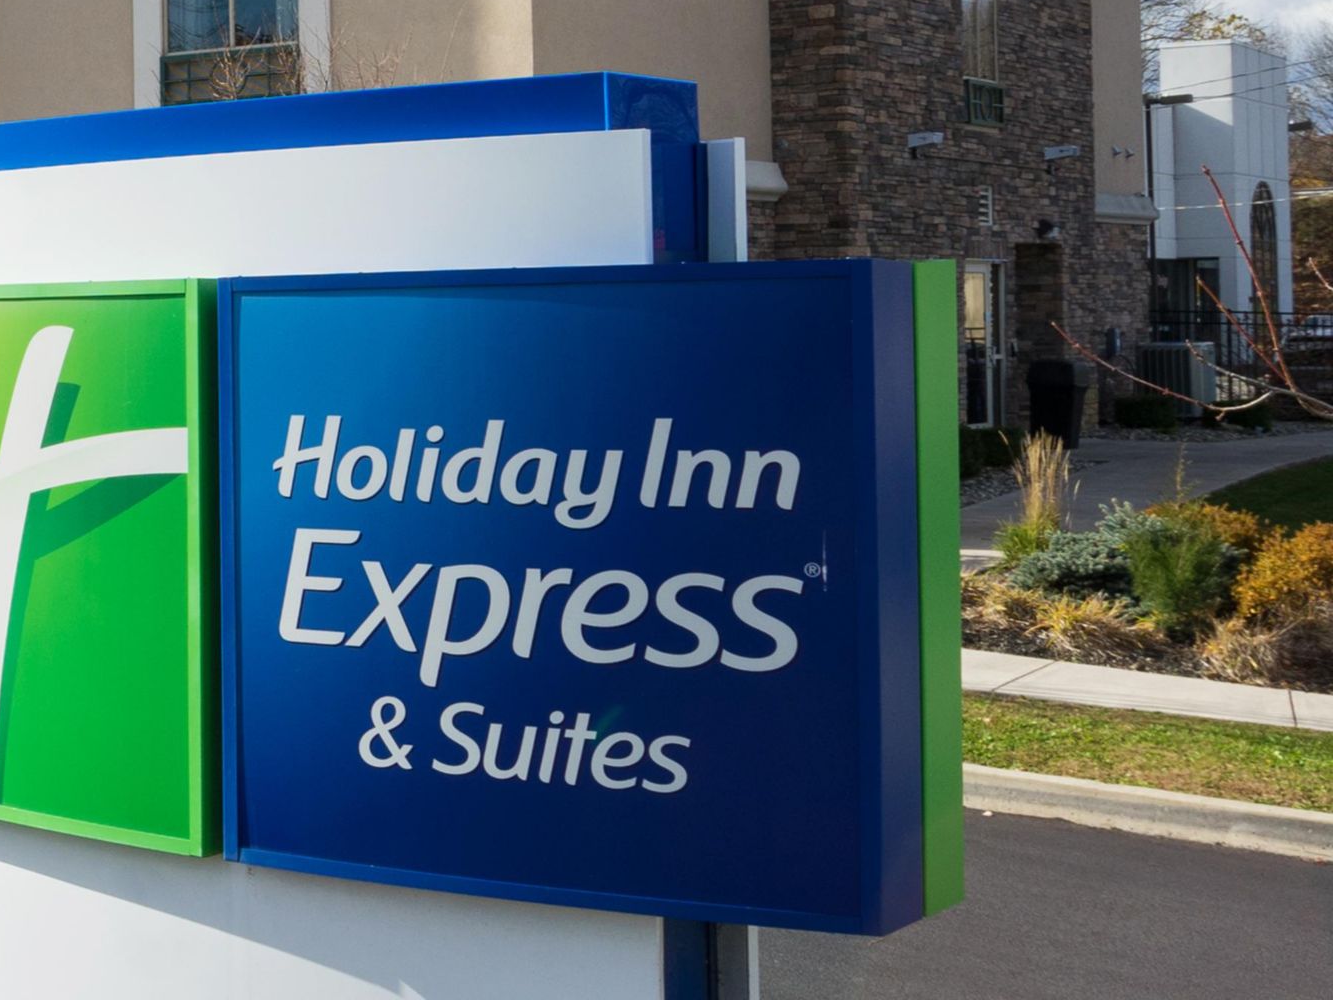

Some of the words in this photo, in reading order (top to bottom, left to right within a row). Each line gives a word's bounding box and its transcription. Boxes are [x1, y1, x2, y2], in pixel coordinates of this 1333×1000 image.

[272, 414, 624, 529] Holiday
[639, 417, 801, 510] Inn
[278, 527, 804, 688] Express
[358, 695, 414, 770] &
[432, 702, 691, 793] Suites
